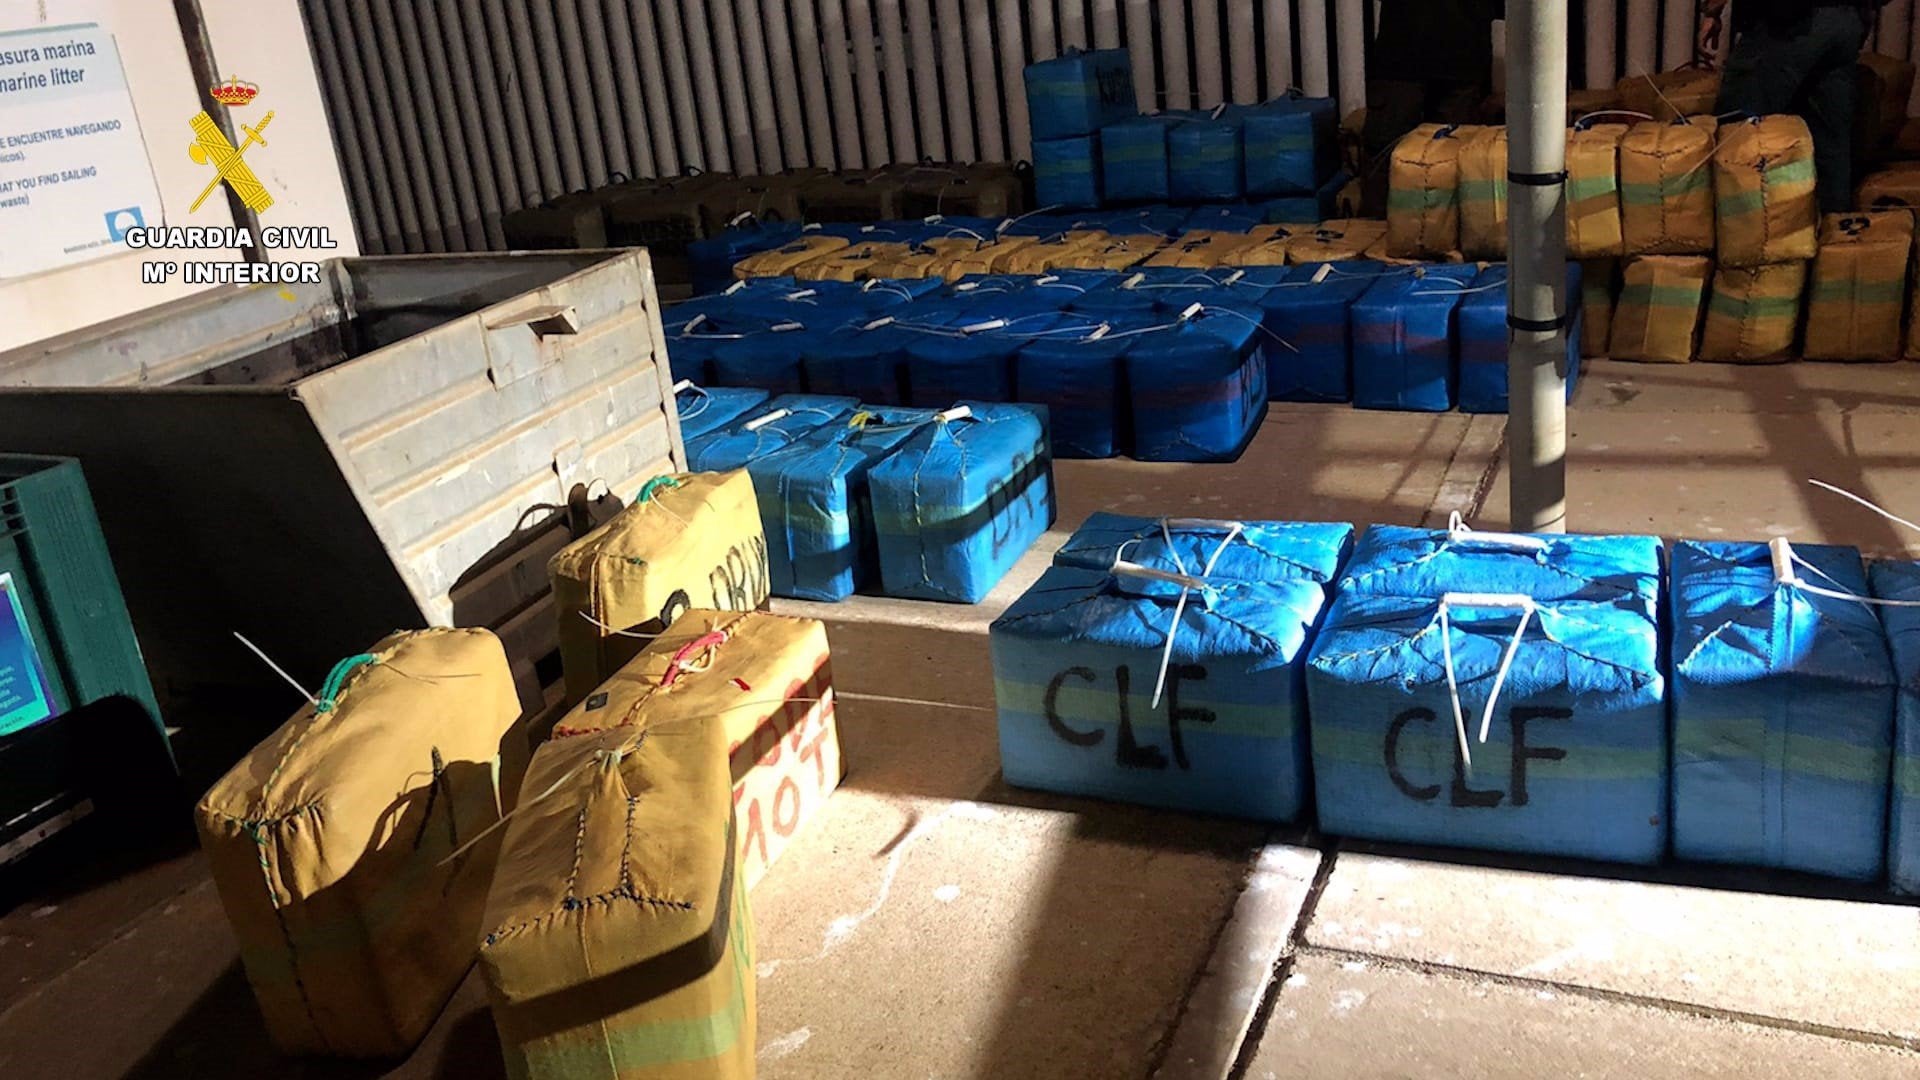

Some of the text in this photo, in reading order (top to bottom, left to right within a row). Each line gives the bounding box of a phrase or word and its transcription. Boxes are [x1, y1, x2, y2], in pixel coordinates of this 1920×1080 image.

[43, 39, 96, 60] marina
[51, 67, 85, 86] litter
[7, 128, 64, 147] ENCUENTRE
[65, 119, 121, 137] NAVEGANDO
[0, 166, 97, 193] AT YOU FIND SAILING
[1043, 664, 1217, 770] CLF
[1384, 706, 1574, 808] CLF
